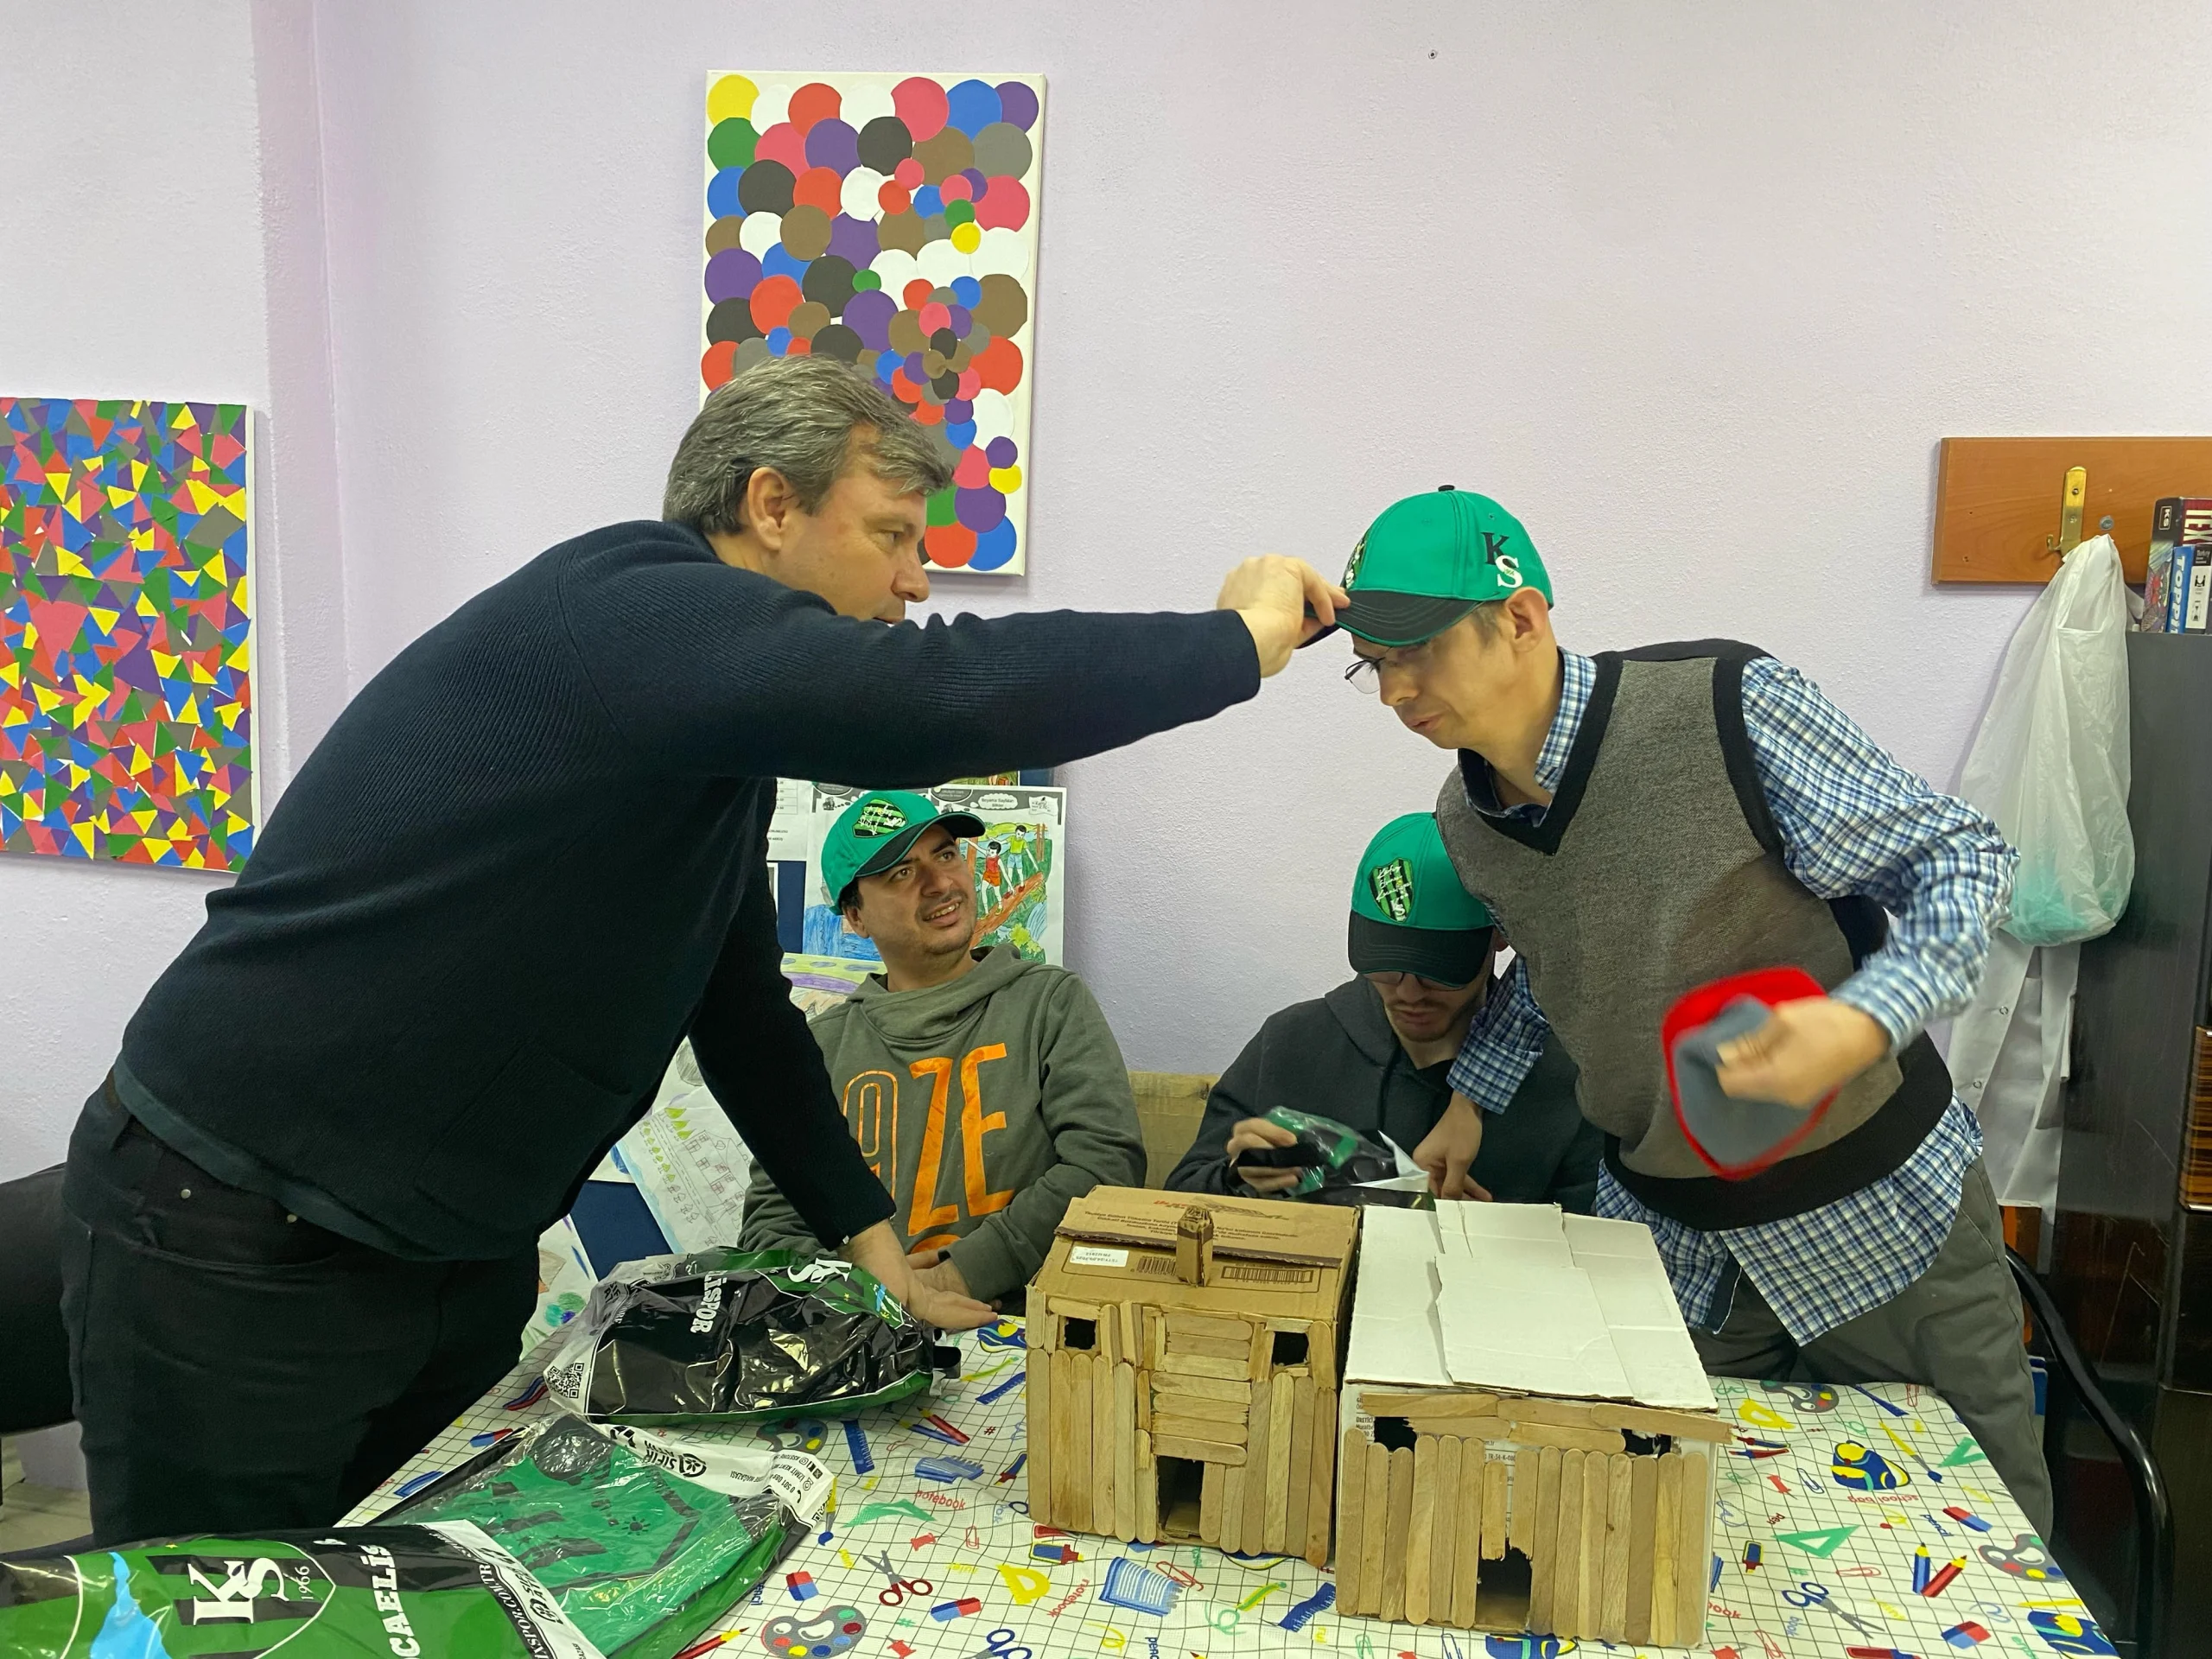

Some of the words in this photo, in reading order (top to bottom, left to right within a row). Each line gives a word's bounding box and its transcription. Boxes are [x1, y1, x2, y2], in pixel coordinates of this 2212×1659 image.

[1480, 531, 1523, 588] KS
[787, 1257, 853, 1283] KS
[914, 1489, 966, 1510] notebook
[1847, 1495, 1874, 1503] bag
[1878, 1494, 1920, 1503] school
[1920, 1514, 1955, 1536] pencil
[188, 1557, 289, 1626] KS
[296, 1565, 315, 1601] 1966
[749, 1582, 766, 1606] encil
[358, 1544, 421, 1659] CAELİS
[1046, 1579, 1090, 1618] notebook
[1786, 1615, 1803, 1637] book
